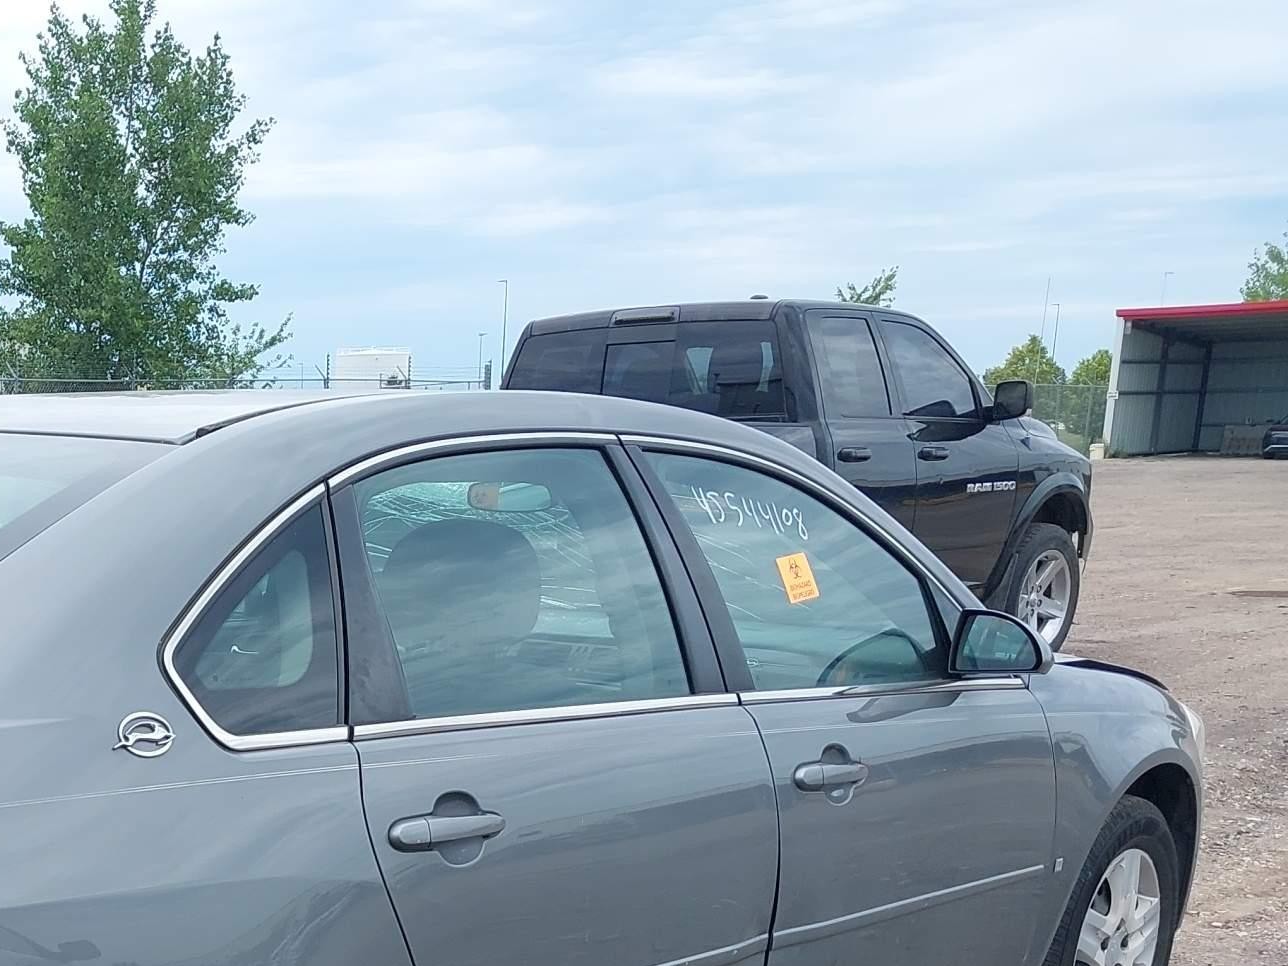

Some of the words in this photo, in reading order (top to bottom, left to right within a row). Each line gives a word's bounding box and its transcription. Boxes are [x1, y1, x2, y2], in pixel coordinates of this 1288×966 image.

[966, 482, 992, 493] RAM
[993, 480, 1016, 491] 1500
[691, 485, 808, 540] 45544108
